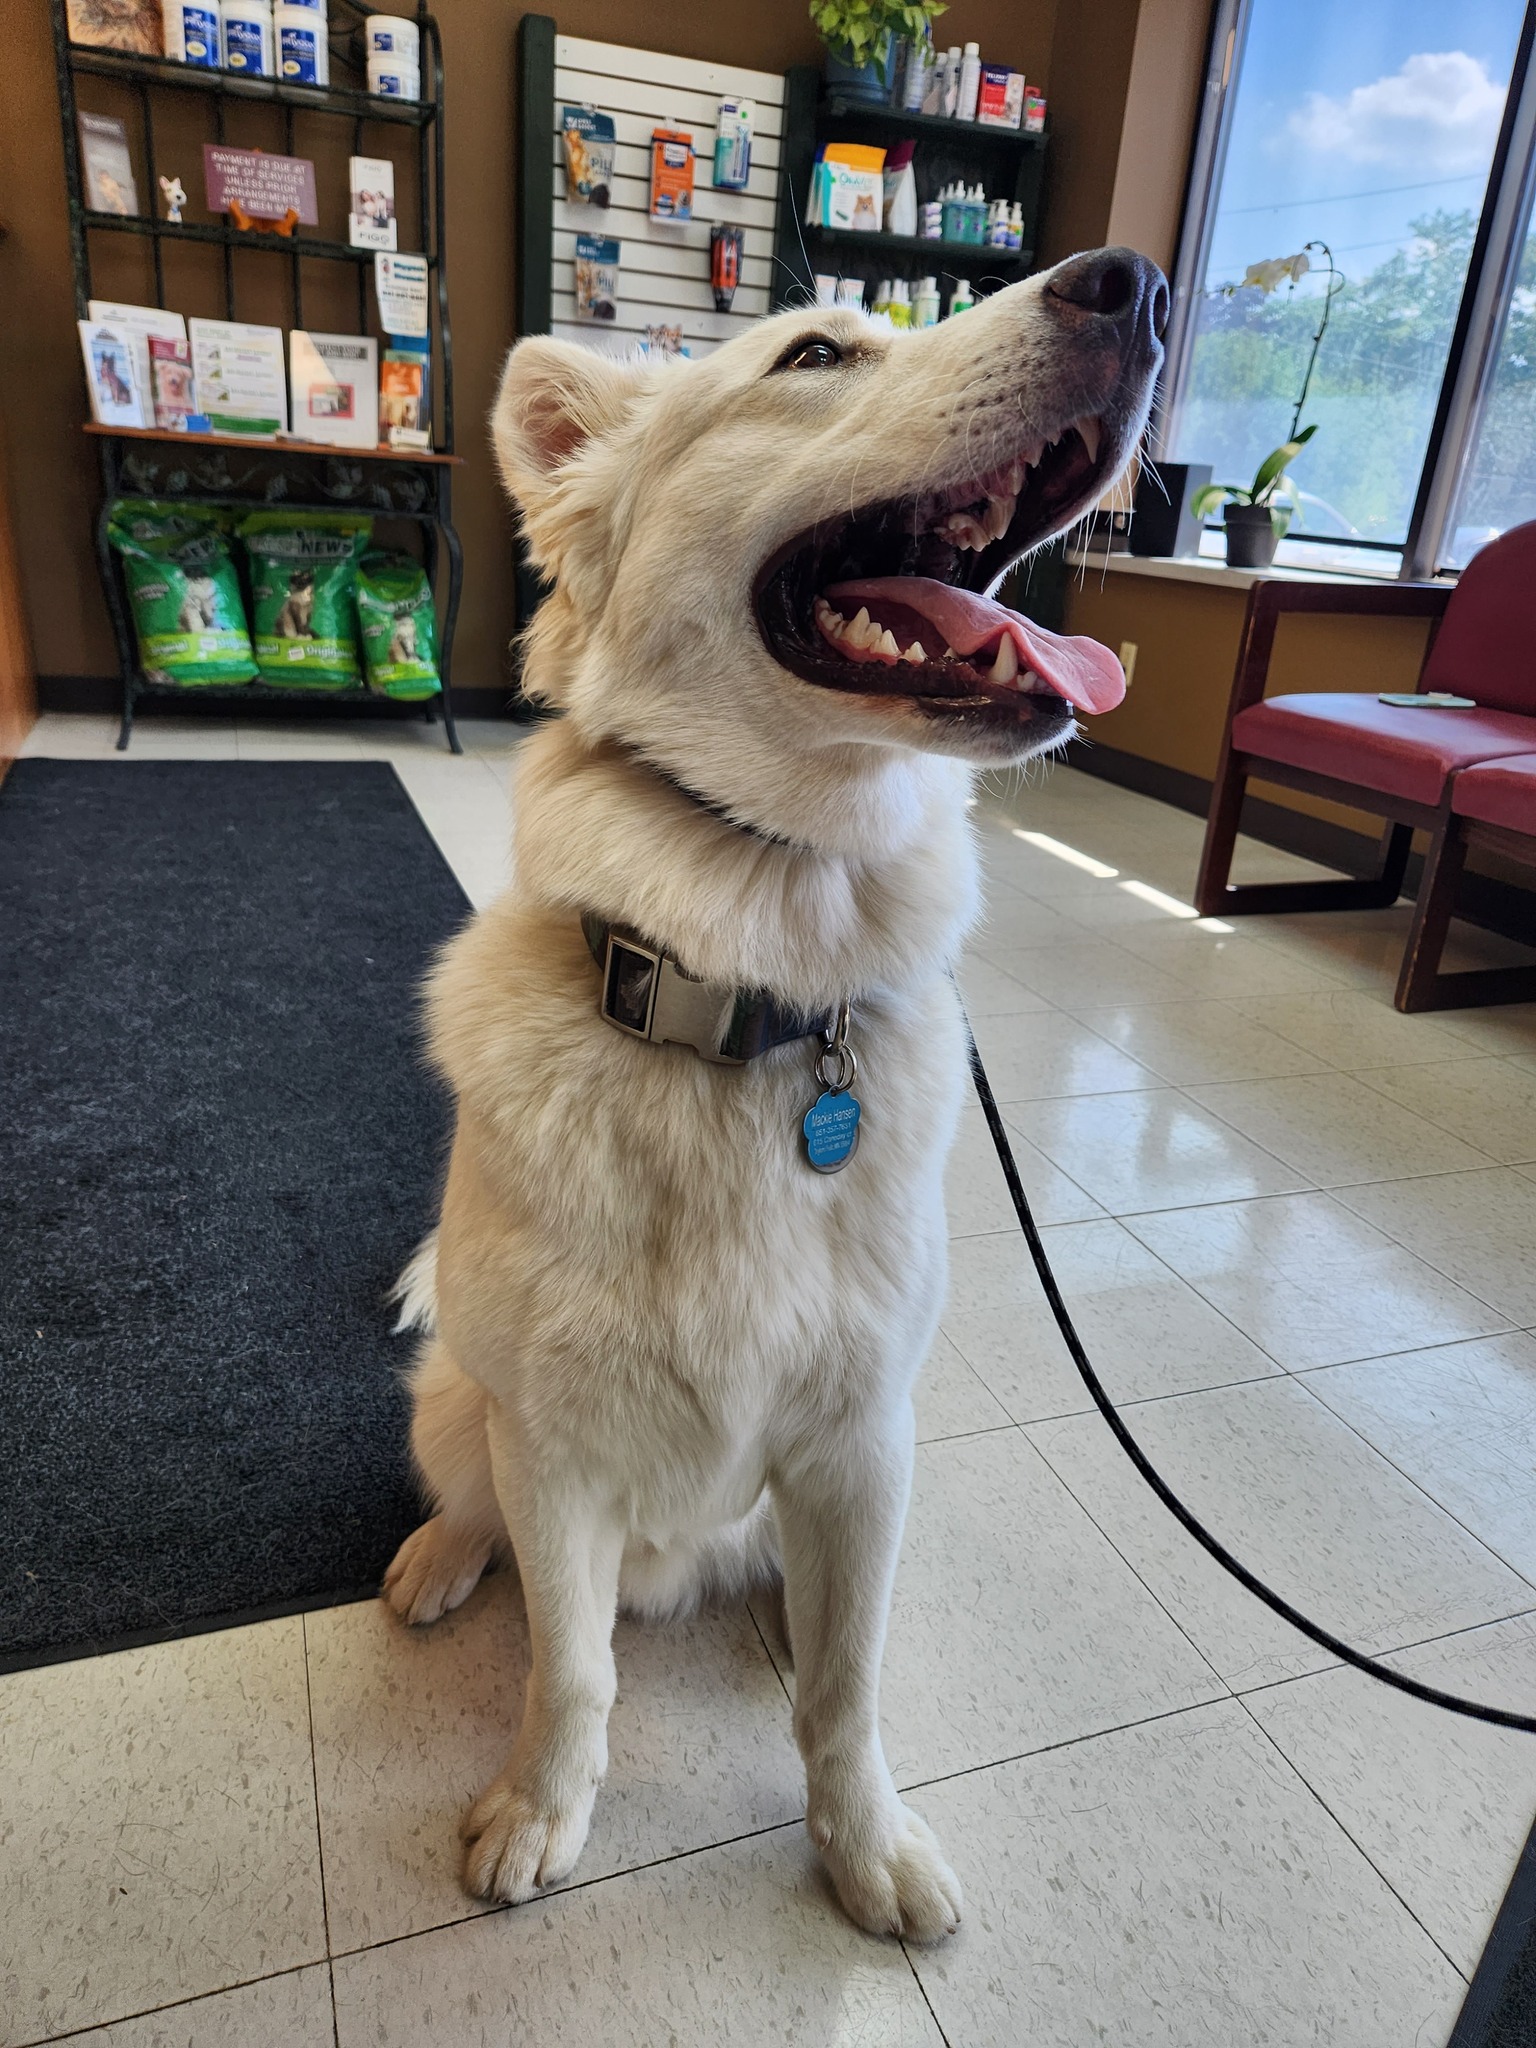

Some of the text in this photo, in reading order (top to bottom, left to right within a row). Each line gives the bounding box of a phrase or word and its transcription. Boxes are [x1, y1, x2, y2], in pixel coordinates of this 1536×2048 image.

[211, 152, 306, 175] PAYMENT IS DUE AT
[215, 163, 305, 186] TIME OF SERVICES
[225, 176, 297, 194] UNLESS PRIOR
[223, 186, 301, 205] ARRANGEMENTS
[248, 199, 273, 212] BEEN
